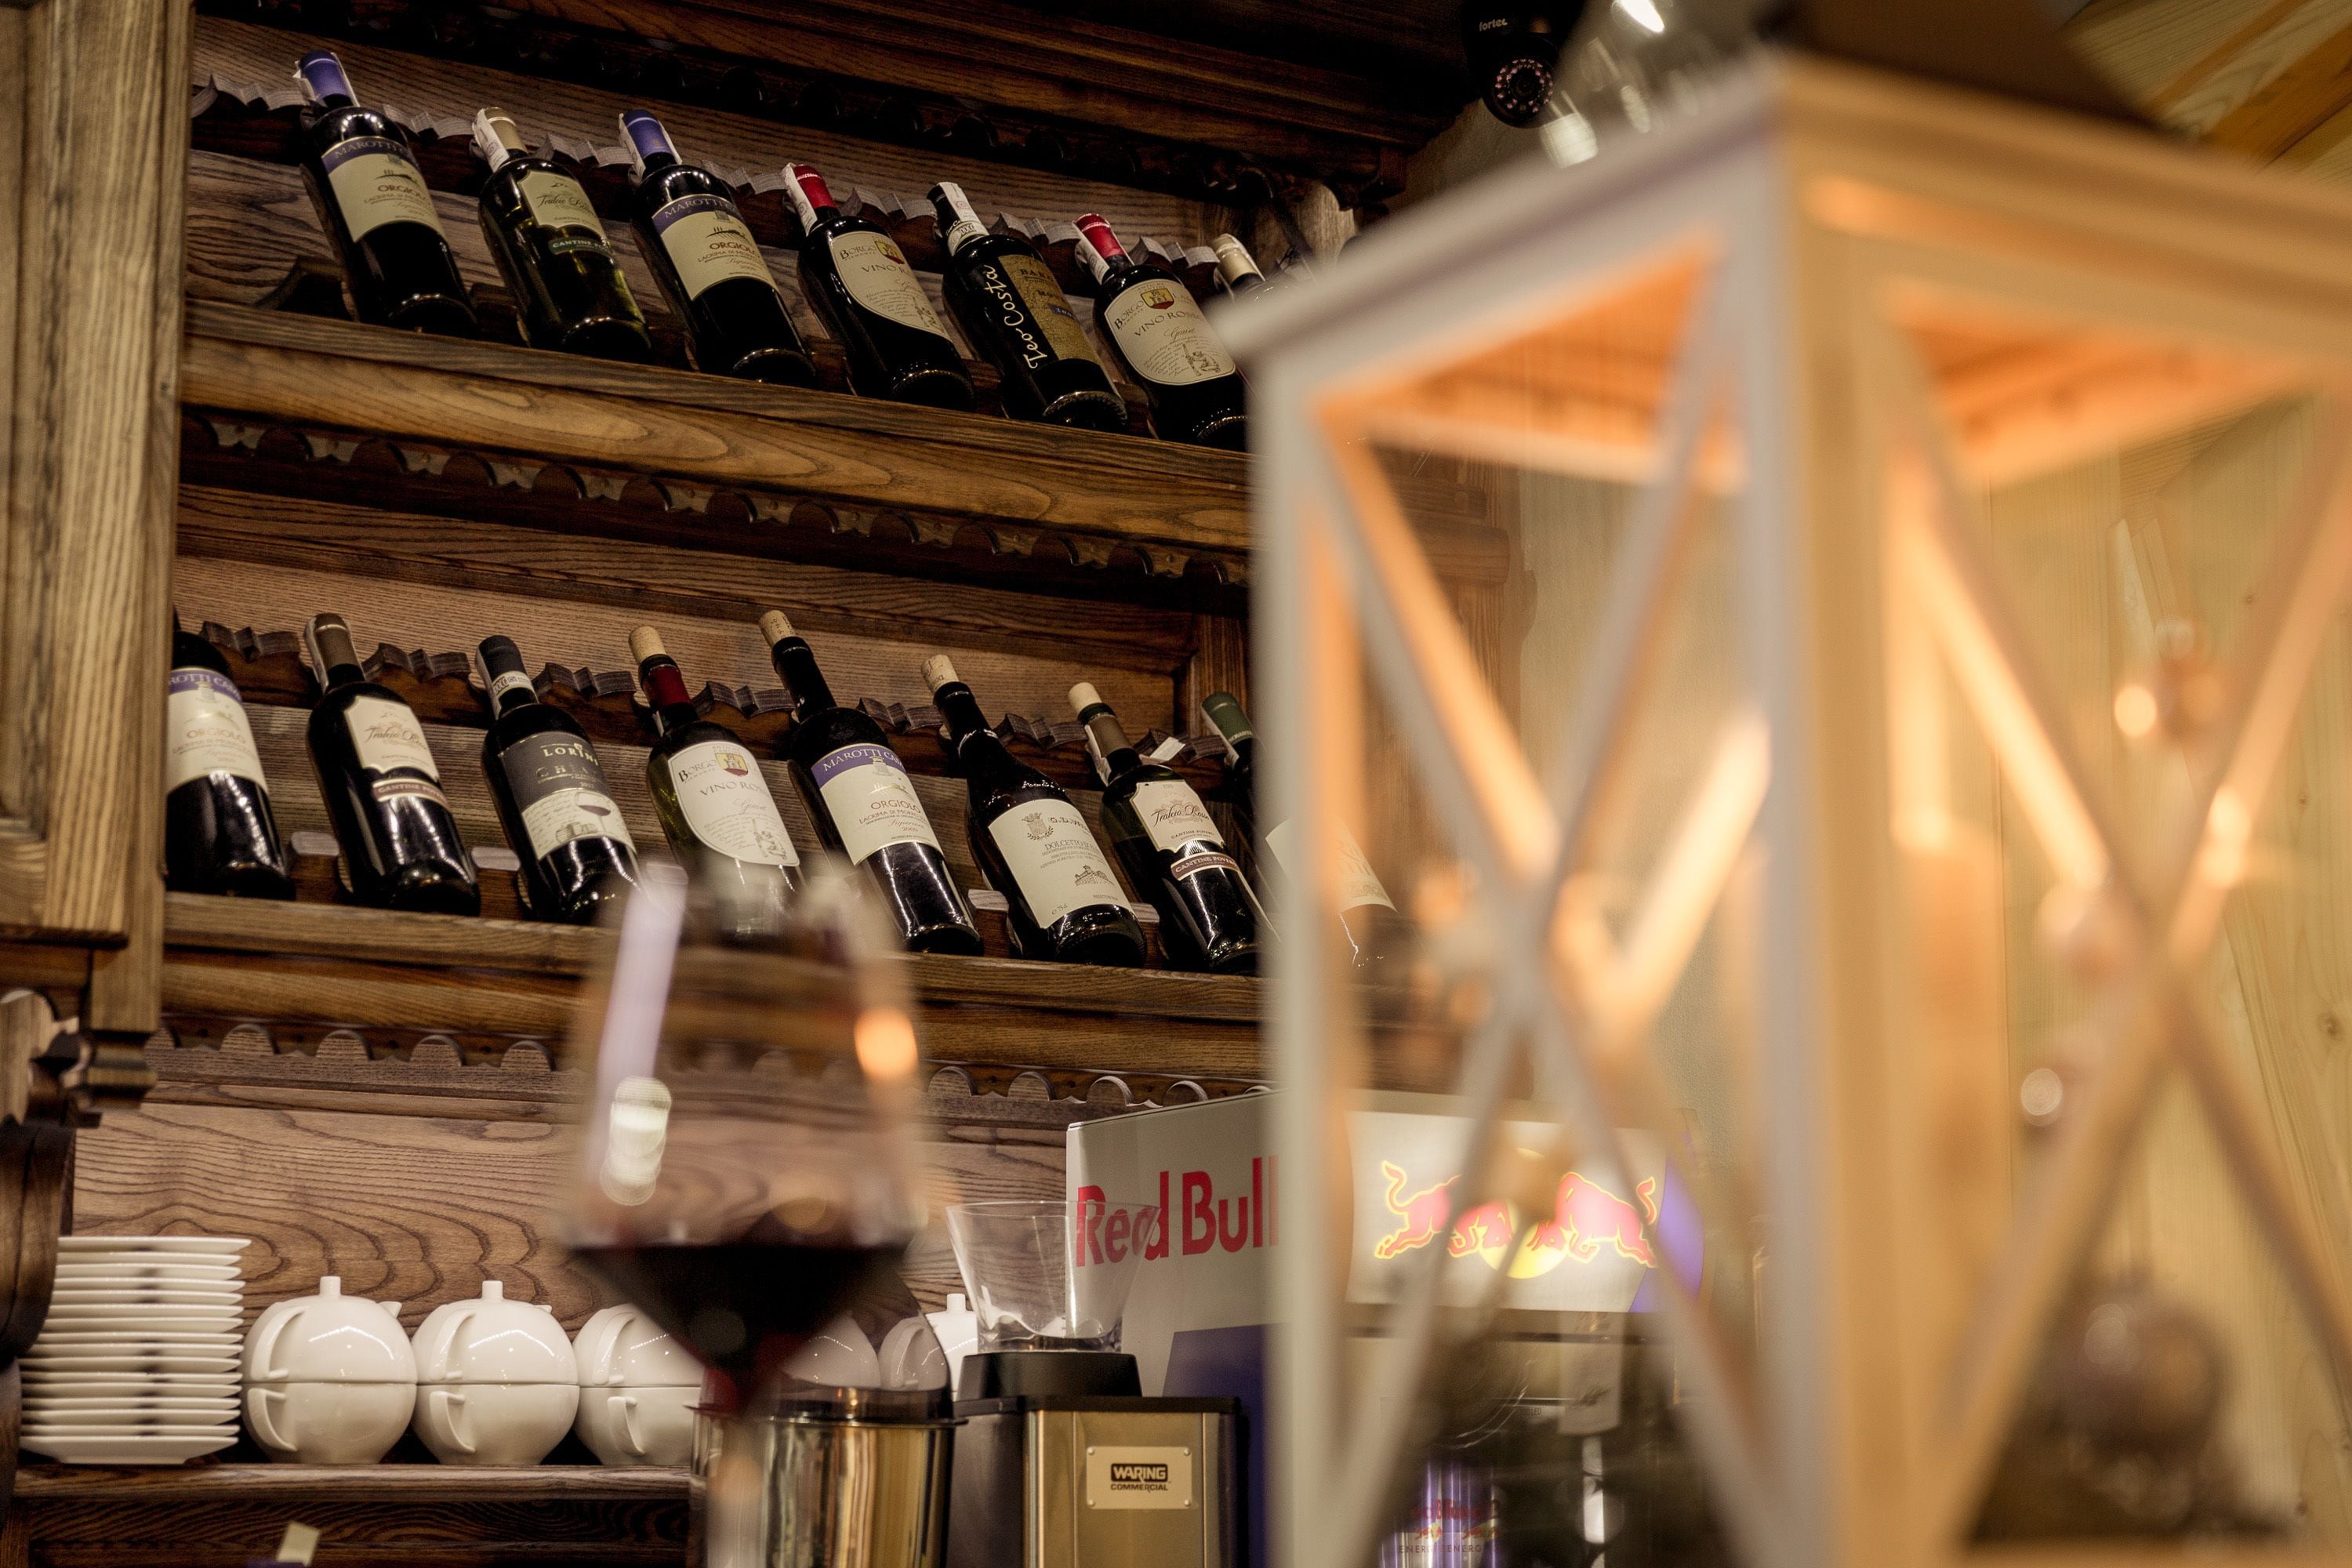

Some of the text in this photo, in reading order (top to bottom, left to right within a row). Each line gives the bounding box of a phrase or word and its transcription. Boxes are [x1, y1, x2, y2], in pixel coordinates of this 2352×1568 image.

[664, 198, 723, 219] MAROTTI
[840, 245, 877, 260] BORGO
[861, 264, 896, 273] VINO
[1113, 300, 1145, 330] BORGO
[1134, 315, 1165, 337] VINO
[823, 749, 882, 772] MAROTTI
[678, 759, 717, 782] BORGO
[699, 781, 736, 797] VINO
[870, 800, 921, 814] ORGIOLO
[859, 811, 887, 824] LACRIMA
[1150, 804, 1182, 828] Tralcio
[1171, 829, 1195, 839] CANTINE
[1044, 839, 1083, 851] DOLCETTO
[1175, 856, 1213, 873] CANTINE
[1076, 1154, 1279, 1267] Red Bull
[1113, 1466, 1167, 1483] WARING
[1110, 1483, 1168, 1494] COMMERCIAL
